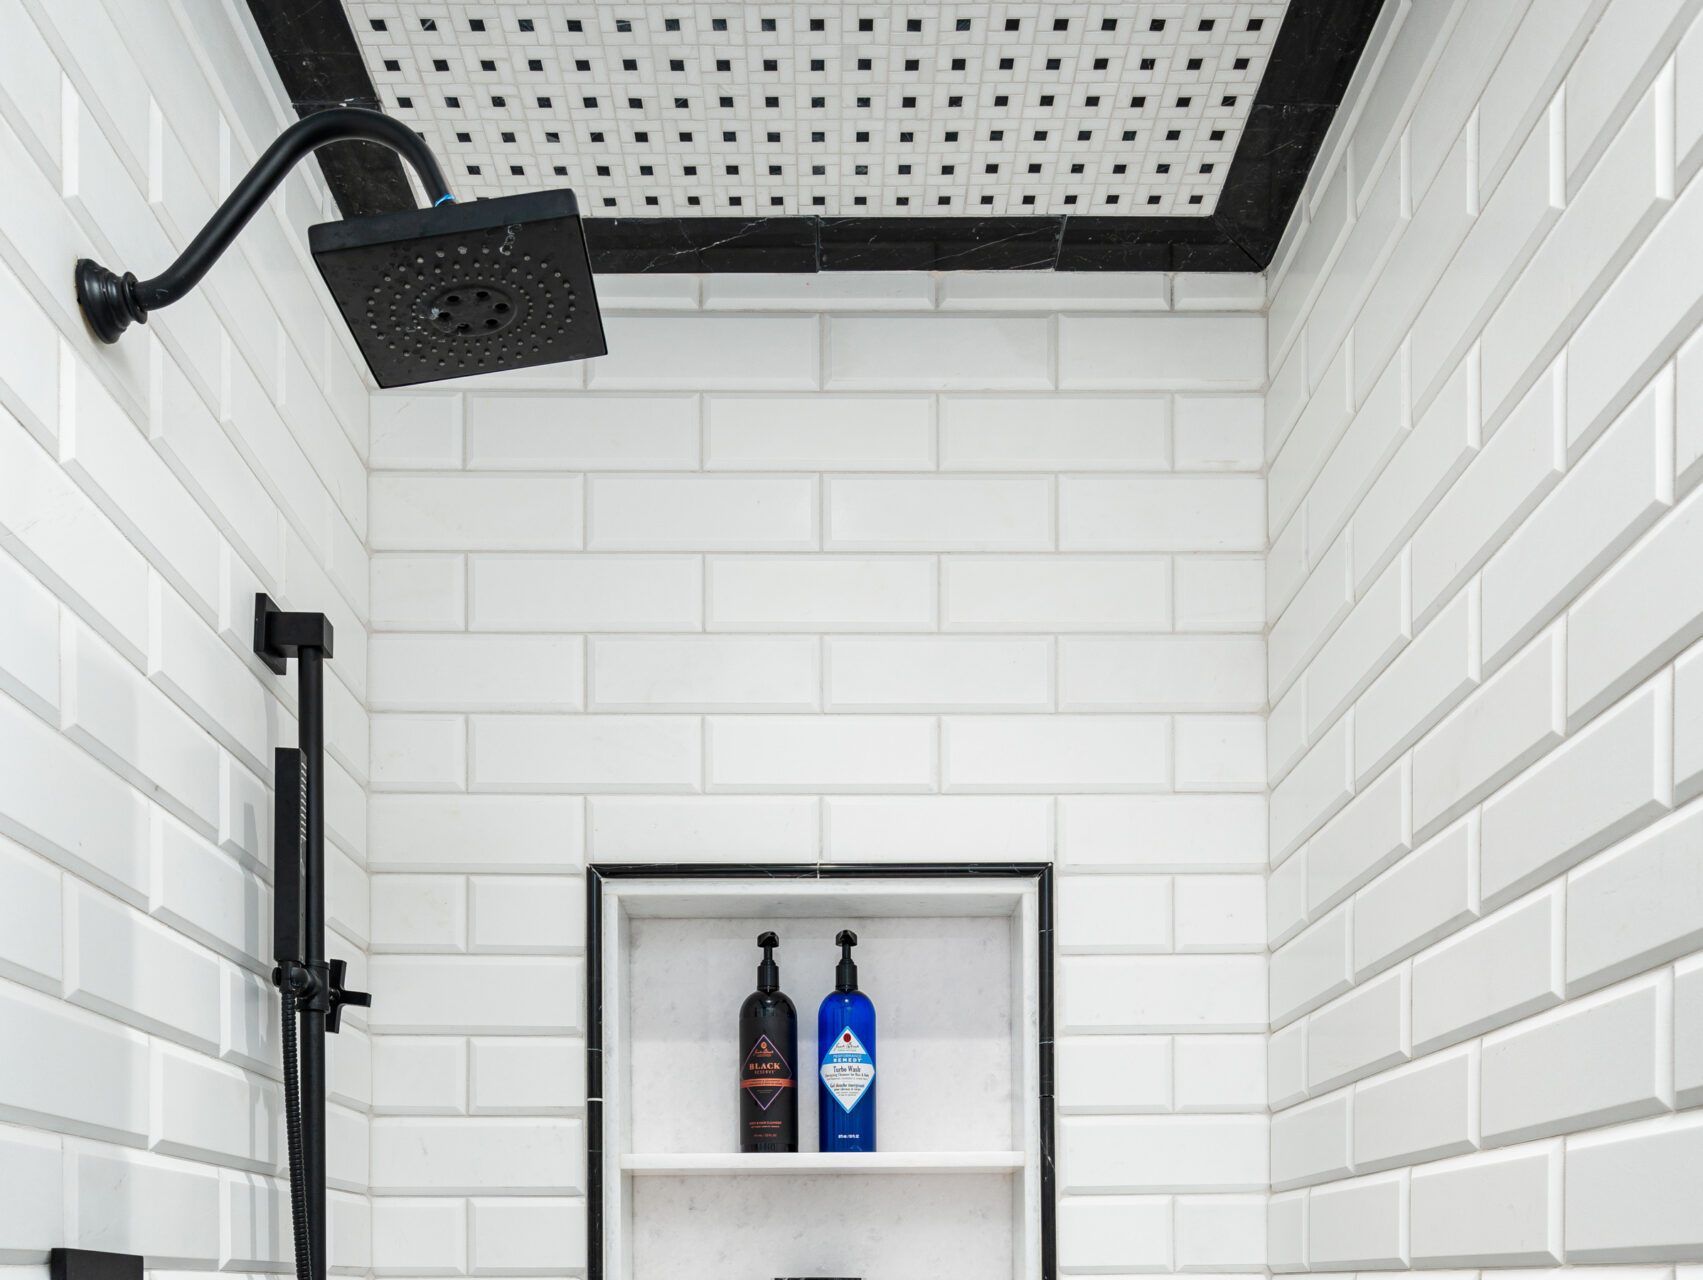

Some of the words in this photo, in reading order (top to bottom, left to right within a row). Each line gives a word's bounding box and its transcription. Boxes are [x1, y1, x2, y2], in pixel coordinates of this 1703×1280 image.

[749, 1062, 780, 1070] BLACK
[833, 1065, 847, 1073] Turbo
[848, 1065, 861, 1073] Wash
